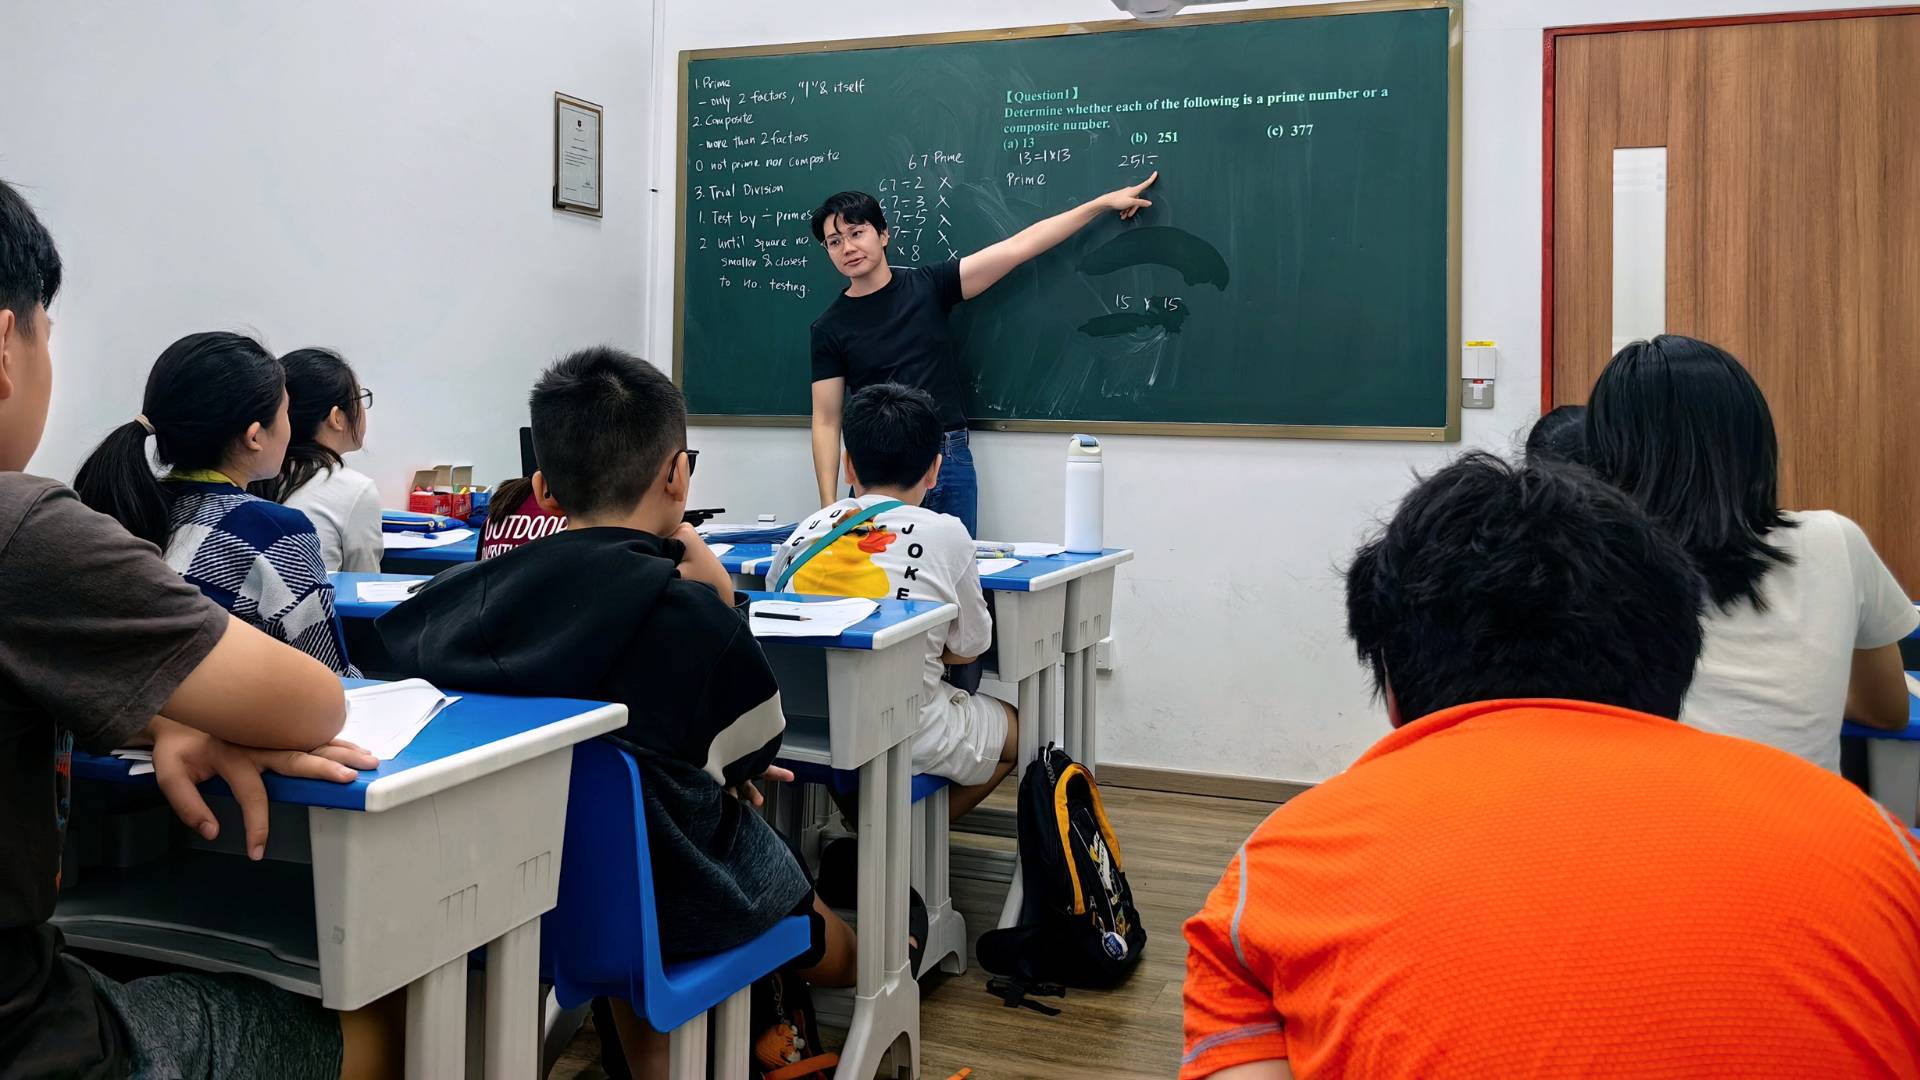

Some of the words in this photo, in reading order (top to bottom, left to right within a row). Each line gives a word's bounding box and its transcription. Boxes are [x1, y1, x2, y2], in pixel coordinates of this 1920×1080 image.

[702, 76, 732, 90] Prime
[711, 96, 731, 113] only
[738, 93, 746, 104] 2
[750, 90, 795, 105] factors,
[833, 78, 865, 94] itself
[1004, 107, 1062, 118] Determine
[1066, 103, 1112, 115] whether
[1116, 101, 1142, 113] each
[1146, 98, 1160, 110] of
[1161, 98, 1180, 110] the
[1183, 95, 1240, 109] following
[1243, 93, 1253, 105] is
[1256, 95, 1264, 104] a
[1267, 92, 1305, 106] prime
[1309, 88, 1360, 101] number
[1362, 87, 1378, 98] or
[1381, 88, 1389, 97] a
[705, 113, 754, 130] Composite
[1003, 122, 1060, 135] composite
[1063, 119, 1110, 131] number.
[733, 135, 756, 149] than
[761, 132, 769, 145] 2
[771, 130, 809, 145] factors
[1131, 132, 1148, 145] (b)
[1157, 131, 1178, 143] 251
[1267, 125, 1284, 139] (c)
[1290, 124, 1314, 137] 377
[1004, 138, 1019, 150] (a)
[1022, 137, 1035, 148] 13
[711, 158, 727, 171] not
[731, 160, 760, 173] prime
[766, 157, 783, 167] nor
[789, 149, 840, 170] composite
[908, 154, 928, 170] 67
[934, 150, 965, 164] Prime
[1006, 171, 1047, 188] Prime
[709, 184, 735, 199] Trial
[744, 183, 784, 196] Division
[711, 210, 733, 226] Test
[739, 210, 756, 229] by
[776, 209, 813, 227] primes
[718, 234, 745, 249] until
[754, 236, 787, 252] square
[720, 256, 757, 268] smaller
[762, 253, 773, 268] &
[775, 255, 809, 268] closest
[719, 275, 731, 287] to
[1115, 293, 1133, 310] 15
[1164, 296, 1182, 311] 15
